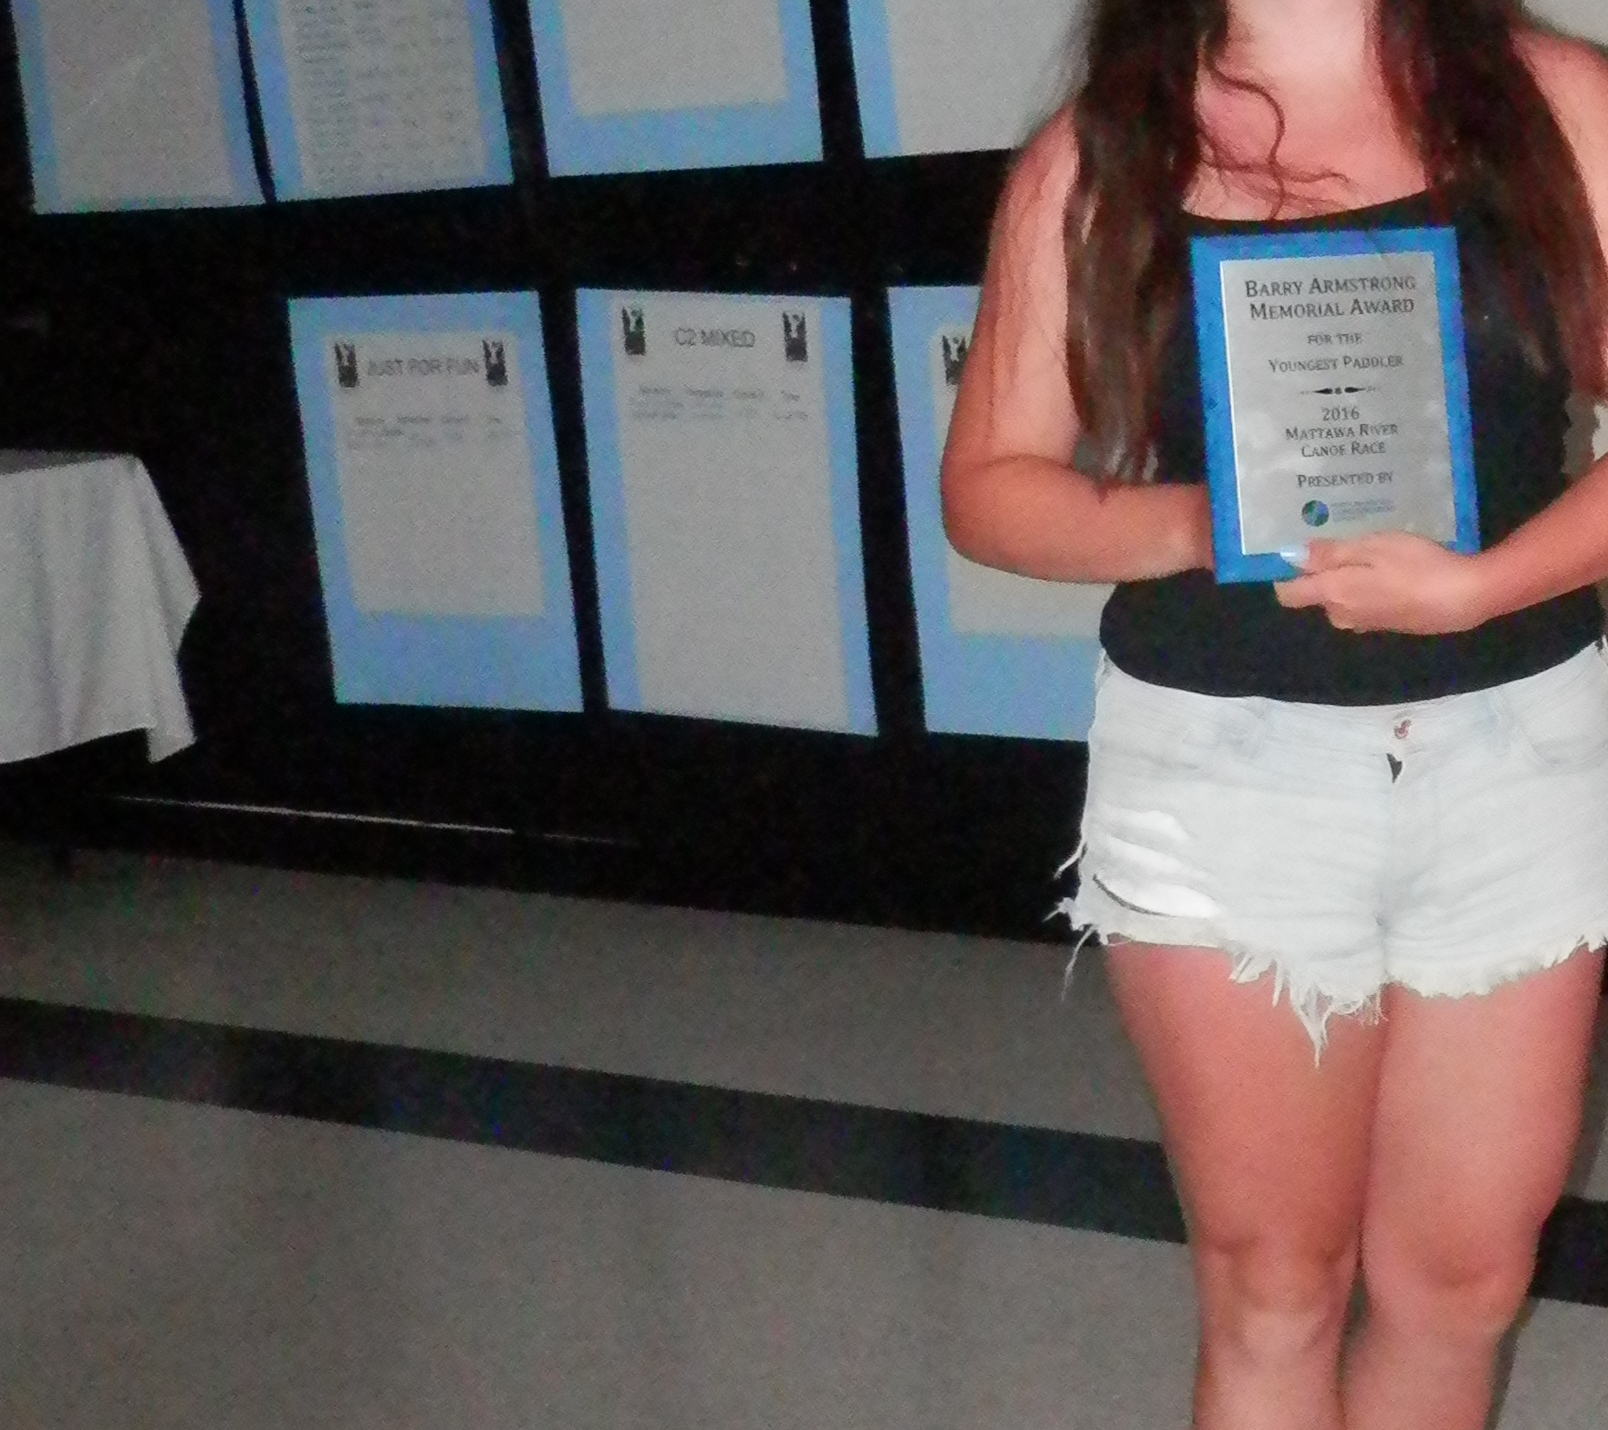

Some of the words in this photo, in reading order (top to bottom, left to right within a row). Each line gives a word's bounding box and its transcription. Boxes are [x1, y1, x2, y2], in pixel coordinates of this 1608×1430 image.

[1245, 280, 1302, 298] BARRY
[1309, 276, 1416, 295] ARMSTRONG
[1250, 302, 1344, 321] MEMORIAL
[1350, 298, 1415, 316] AWARD
[700, 326, 756, 348] MIXED
[1268, 357, 1338, 373] YOUNGEST
[1343, 354, 1404, 369] PADDLER
[1322, 407, 1360, 422] 2016
[1286, 426, 1355, 441] MATTAWA
[1359, 423, 1399, 436] RIVER
[1351, 441, 1386, 455] RACE
[1296, 473, 1374, 488] PRESENTED
[1377, 471, 1394, 485] BY
